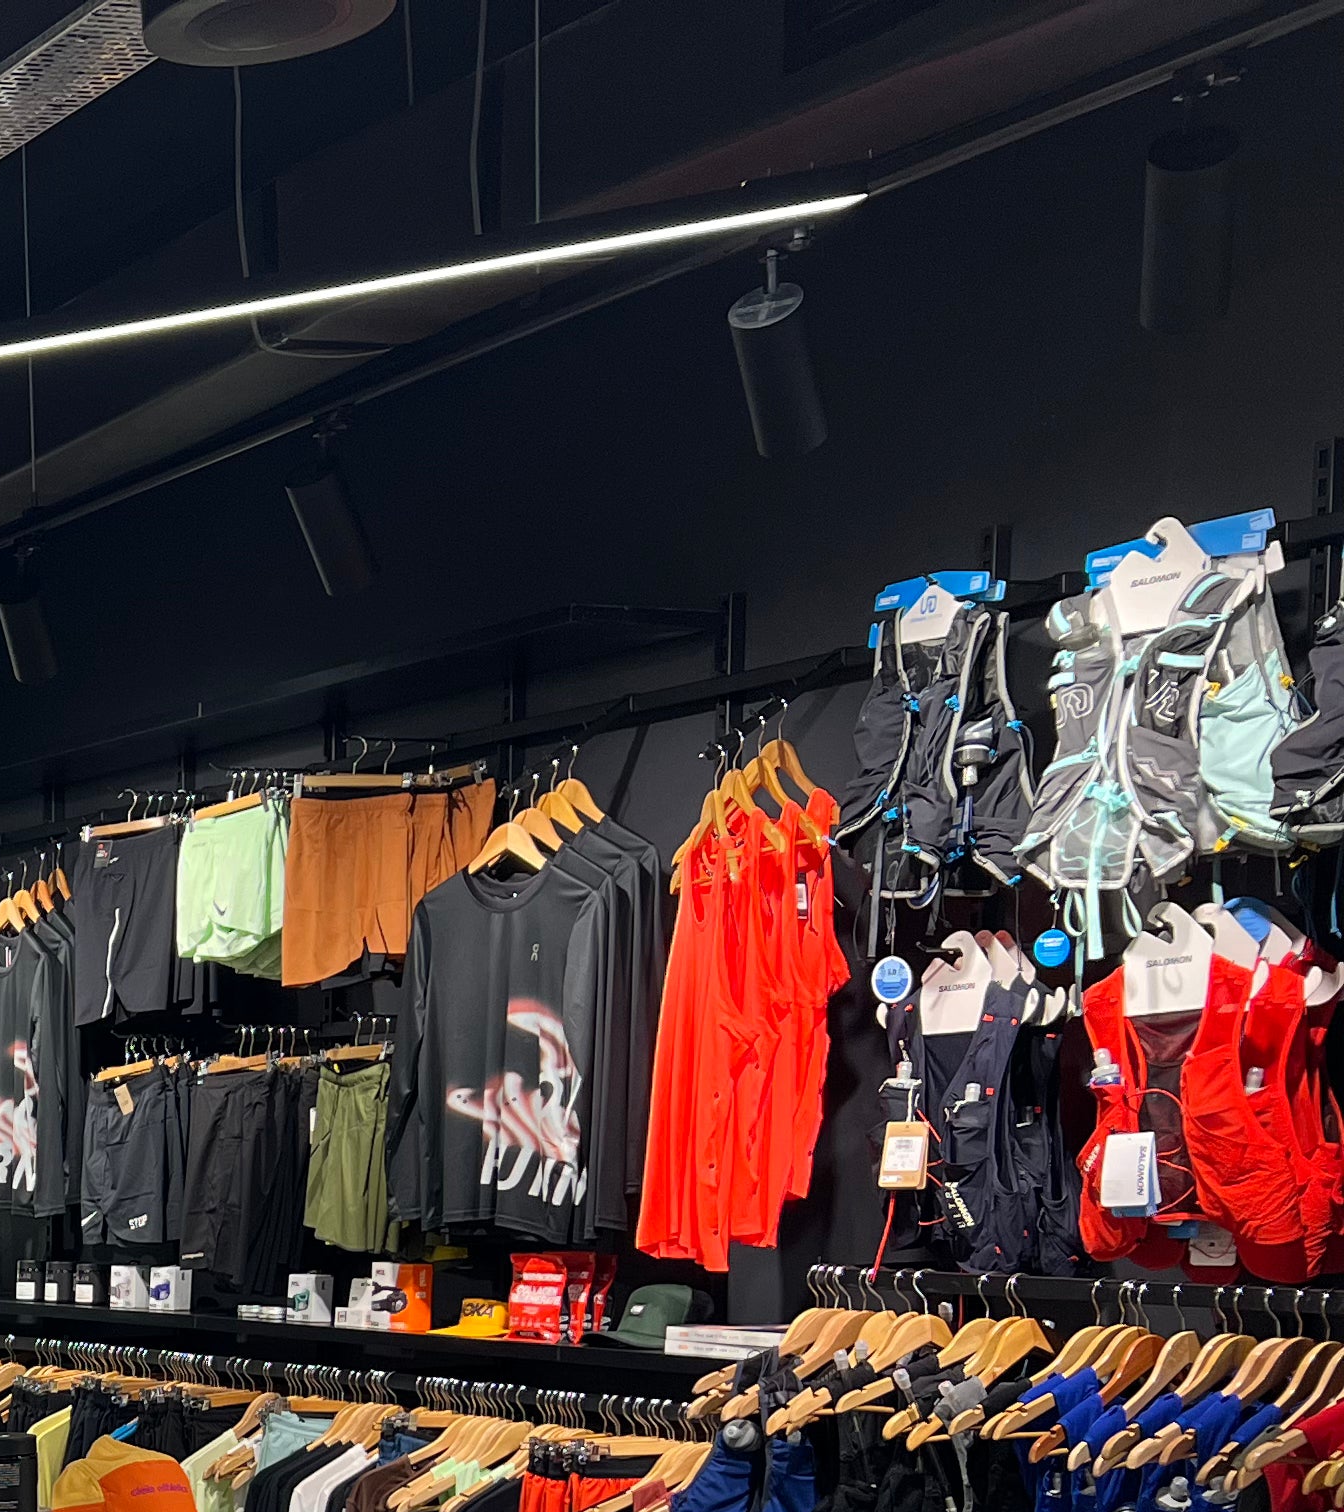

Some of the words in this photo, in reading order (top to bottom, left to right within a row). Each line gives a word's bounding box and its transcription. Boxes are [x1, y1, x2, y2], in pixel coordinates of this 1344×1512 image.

[1130, 572, 1181, 588] SALOMON
[1146, 954, 1193, 969] SALOMON
[938, 981, 976, 993] SALOMON
[1136, 1144, 1148, 1197] SALOMON
[128, 1213, 149, 1230] STOP
